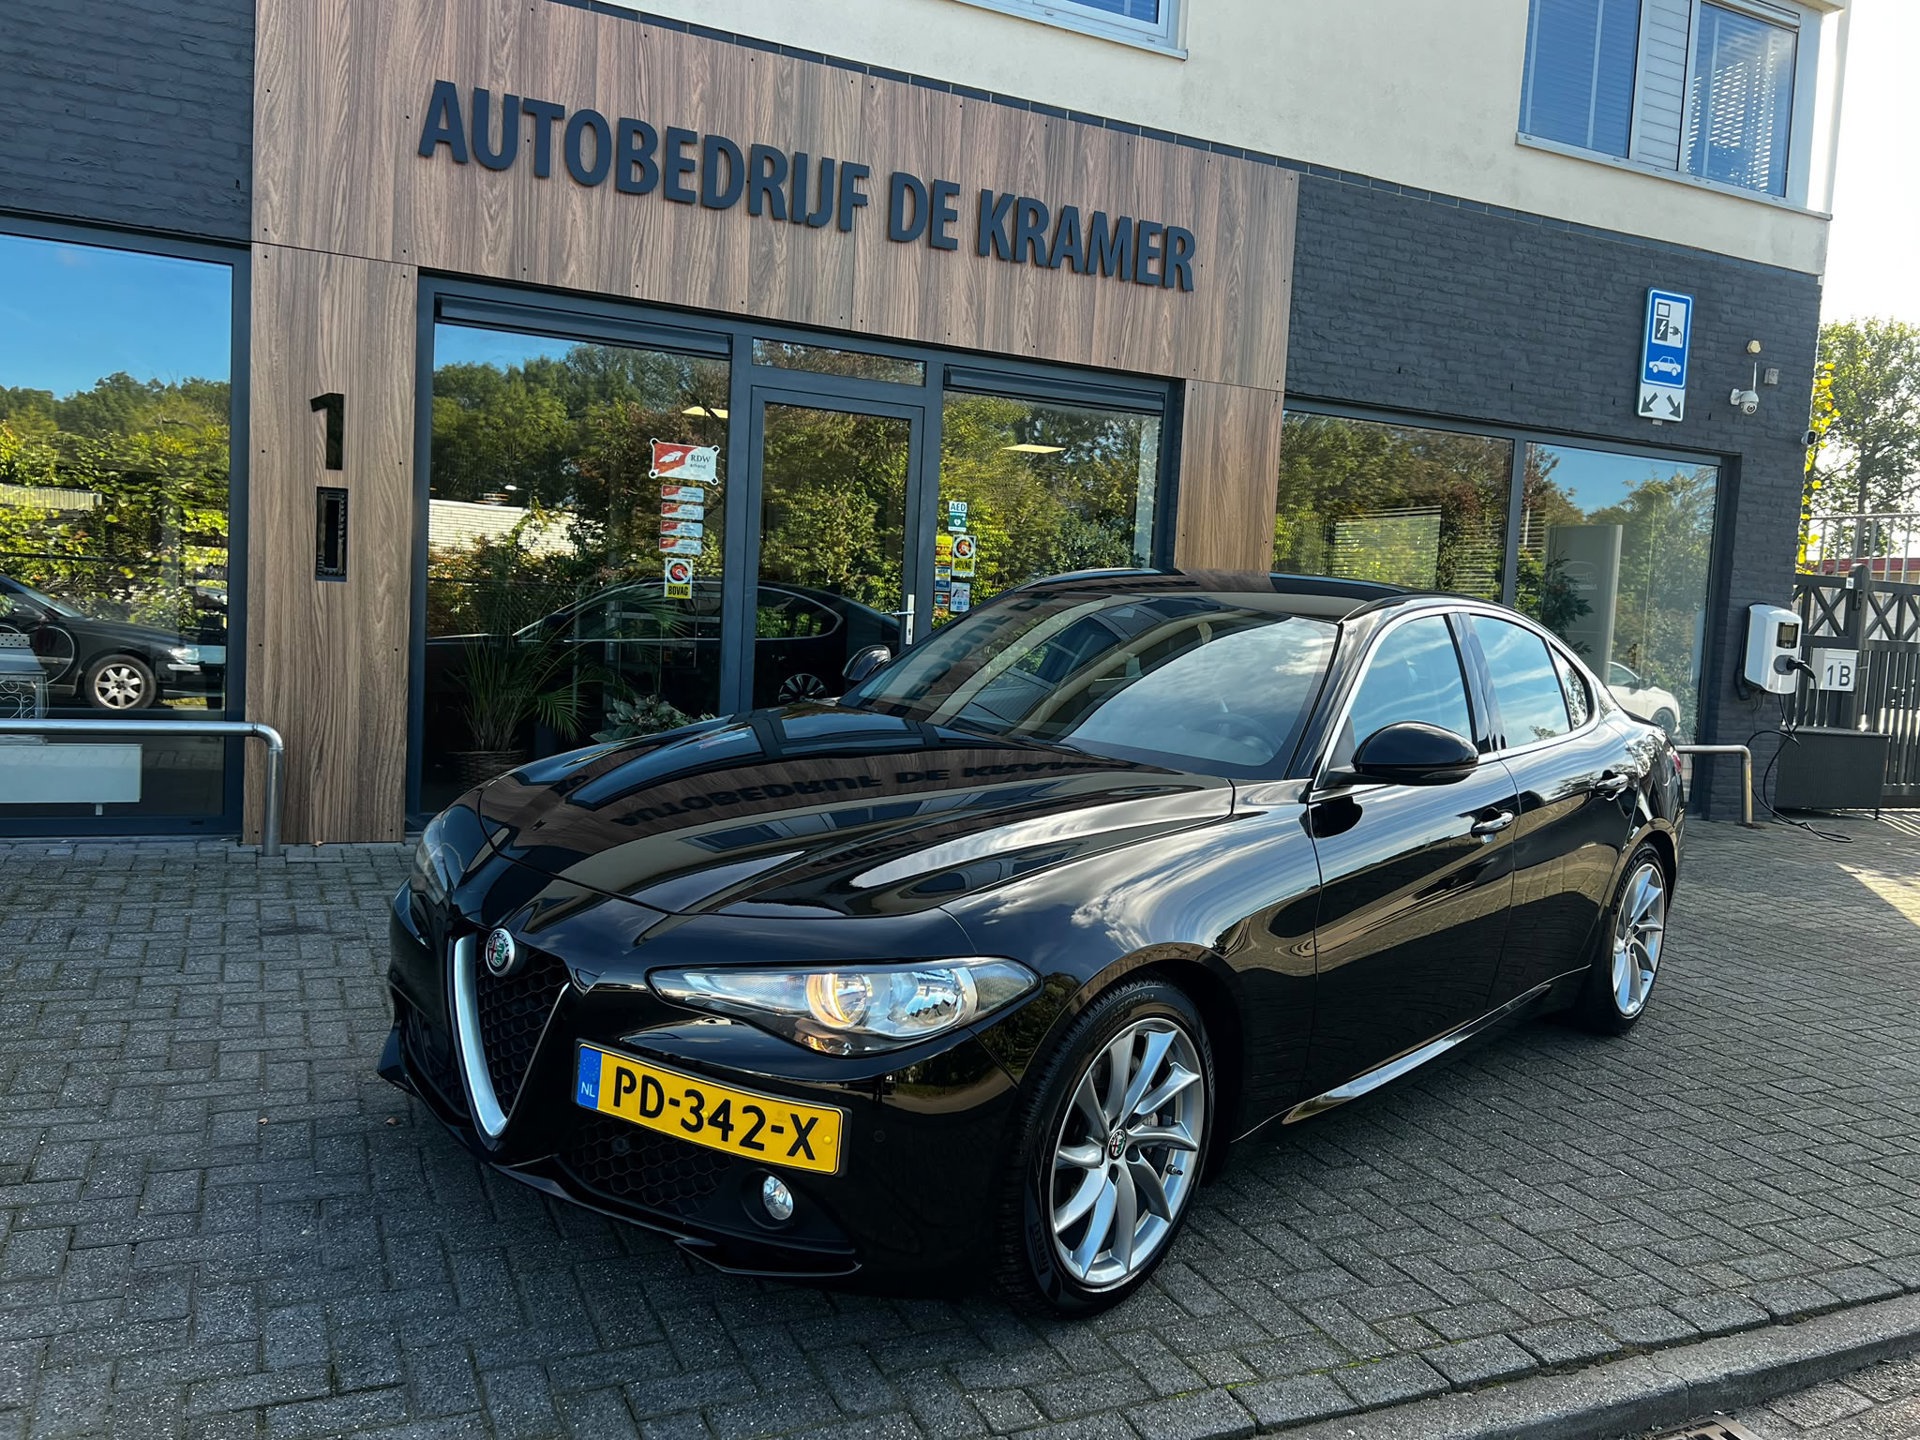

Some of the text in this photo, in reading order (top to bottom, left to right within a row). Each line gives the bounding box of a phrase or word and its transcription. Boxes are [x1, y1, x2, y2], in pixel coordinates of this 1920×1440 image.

[418, 79, 1196, 292] AUTOBEDRIJF DE KRAMER
[310, 393, 345, 470] 1
[690, 454, 711, 463] RDW
[950, 503, 966, 511] AED
[668, 585, 689, 597] BOVAG
[581, 1082, 596, 1098] NL
[613, 1066, 819, 1161] PD-342-X
